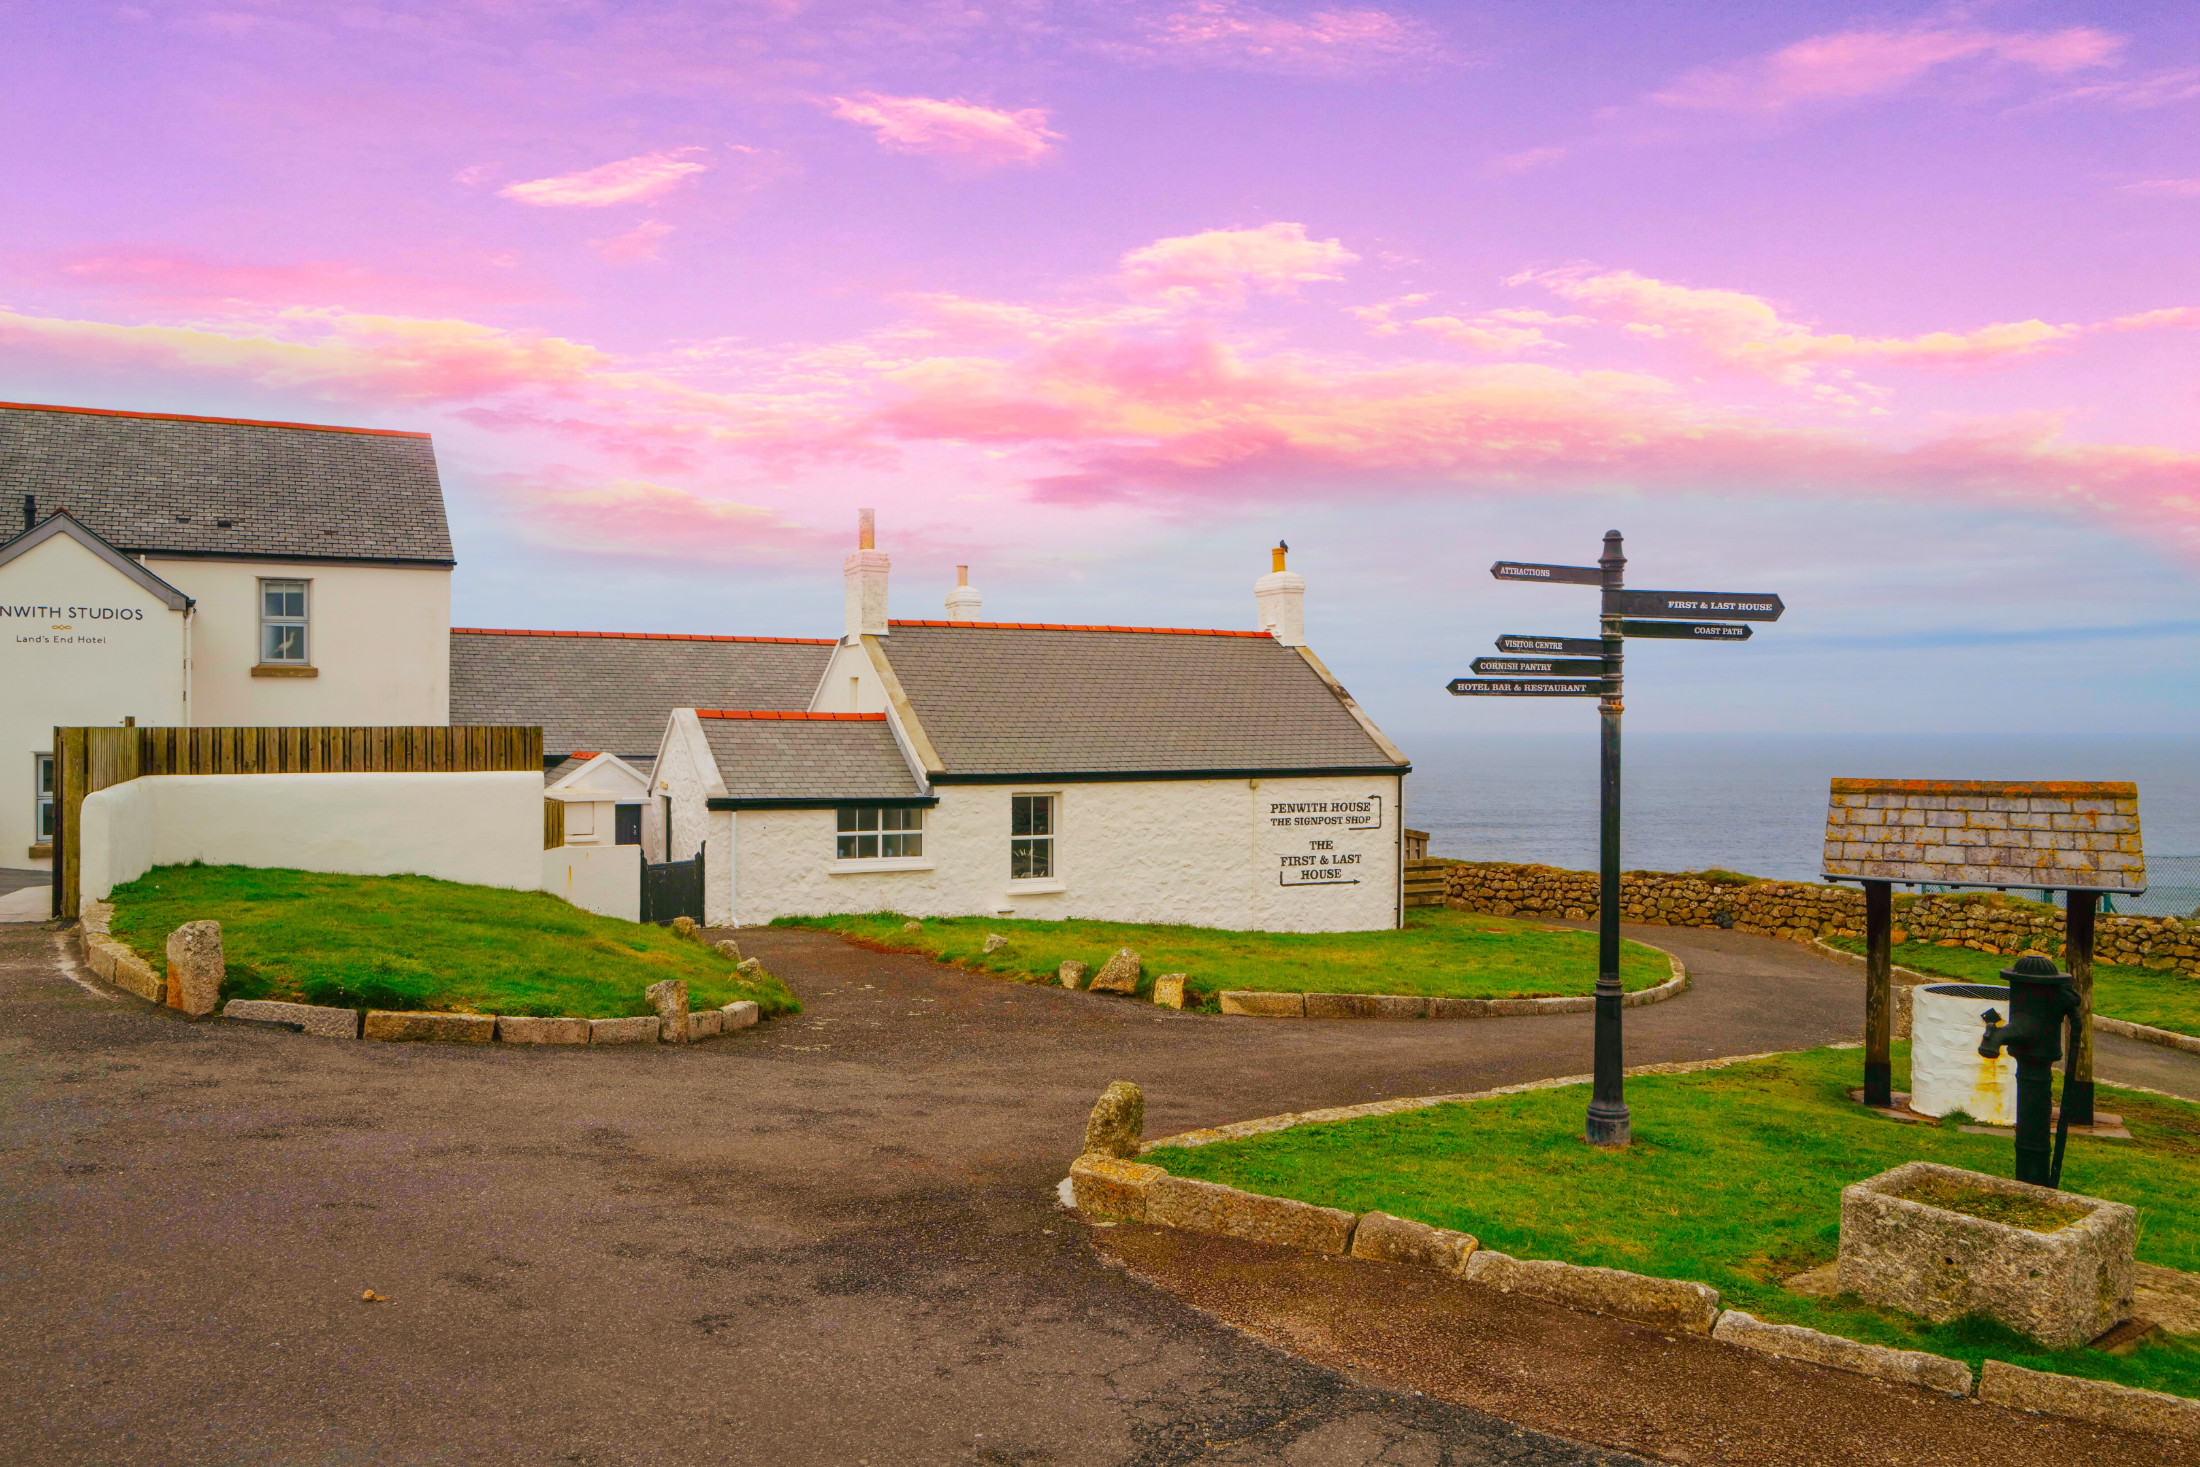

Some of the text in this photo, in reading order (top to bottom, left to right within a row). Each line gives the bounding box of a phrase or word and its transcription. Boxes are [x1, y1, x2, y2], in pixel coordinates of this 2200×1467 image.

[1500, 567, 1550, 577] ATTRACTIONS
[1700, 601, 1708, 609] &
[1711, 602, 1736, 610] LAST
[1738, 603, 1773, 611] HOUSE
[69, 607, 143, 620] STUDIOS
[16, 635, 106, 644] Land's End Hotel
[1505, 640, 1563, 650] VISITOR CENTRE
[1520, 663, 1552, 671] PANTRY
[1457, 683, 1490, 691] HOTEL
[1524, 684, 1587, 692] RESTAURANT
[1270, 802, 1371, 814] PENWITH HOUSE
[1270, 815, 1371, 826] THE SIGNPOST SHOP
[1309, 840, 1334, 850] THE
[1280, 854, 1362, 866] FIRST & LAST
[1301, 869, 1342, 880] HOUSE
